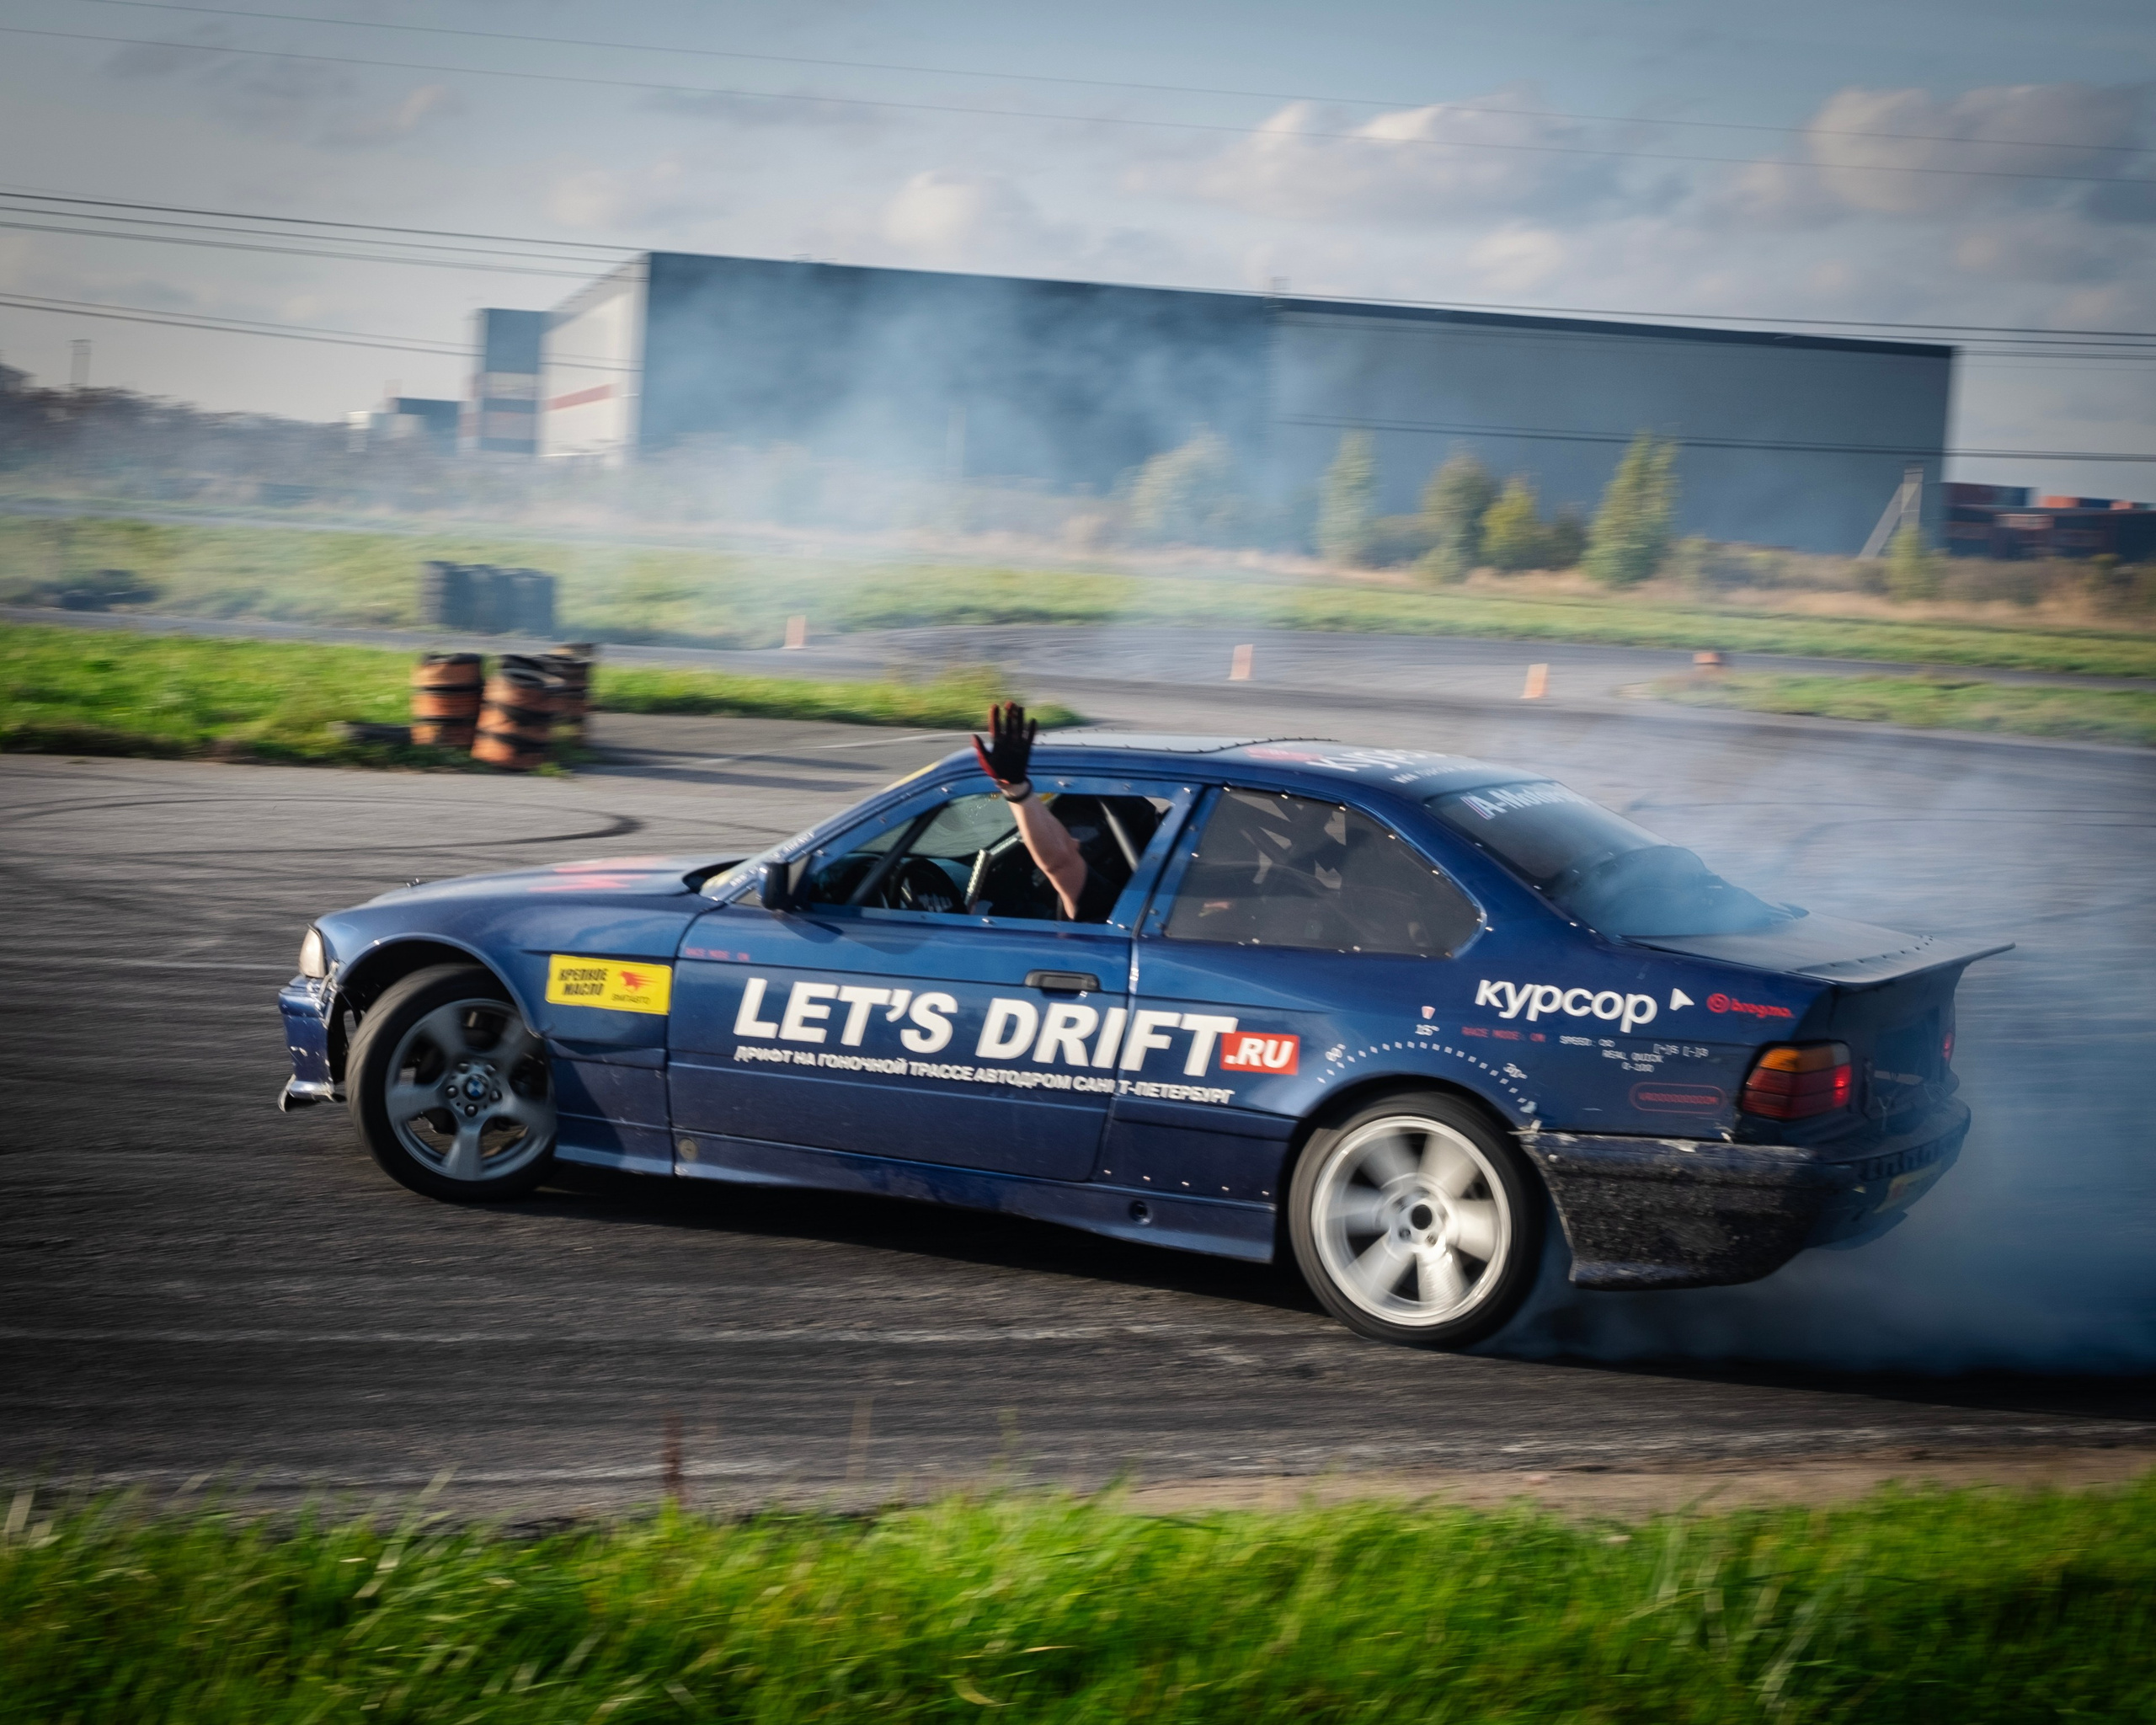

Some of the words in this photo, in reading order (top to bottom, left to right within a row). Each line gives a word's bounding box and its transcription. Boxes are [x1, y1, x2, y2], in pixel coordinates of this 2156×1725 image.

[733, 977, 958, 1054] LET'S
[974, 997, 1239, 1076] DRIFT
[1224, 1036, 1294, 1069] .RU
[1475, 980, 1658, 1033] курсор
[734, 1045, 794, 1065] ДРИФТ
[793, 1051, 819, 1066] НА
[818, 1054, 909, 1076] ГОНОЧНОЙ
[908, 1061, 974, 1081] ТРАССЕ
[972, 1066, 1072, 1090] АВТОДРОМ
